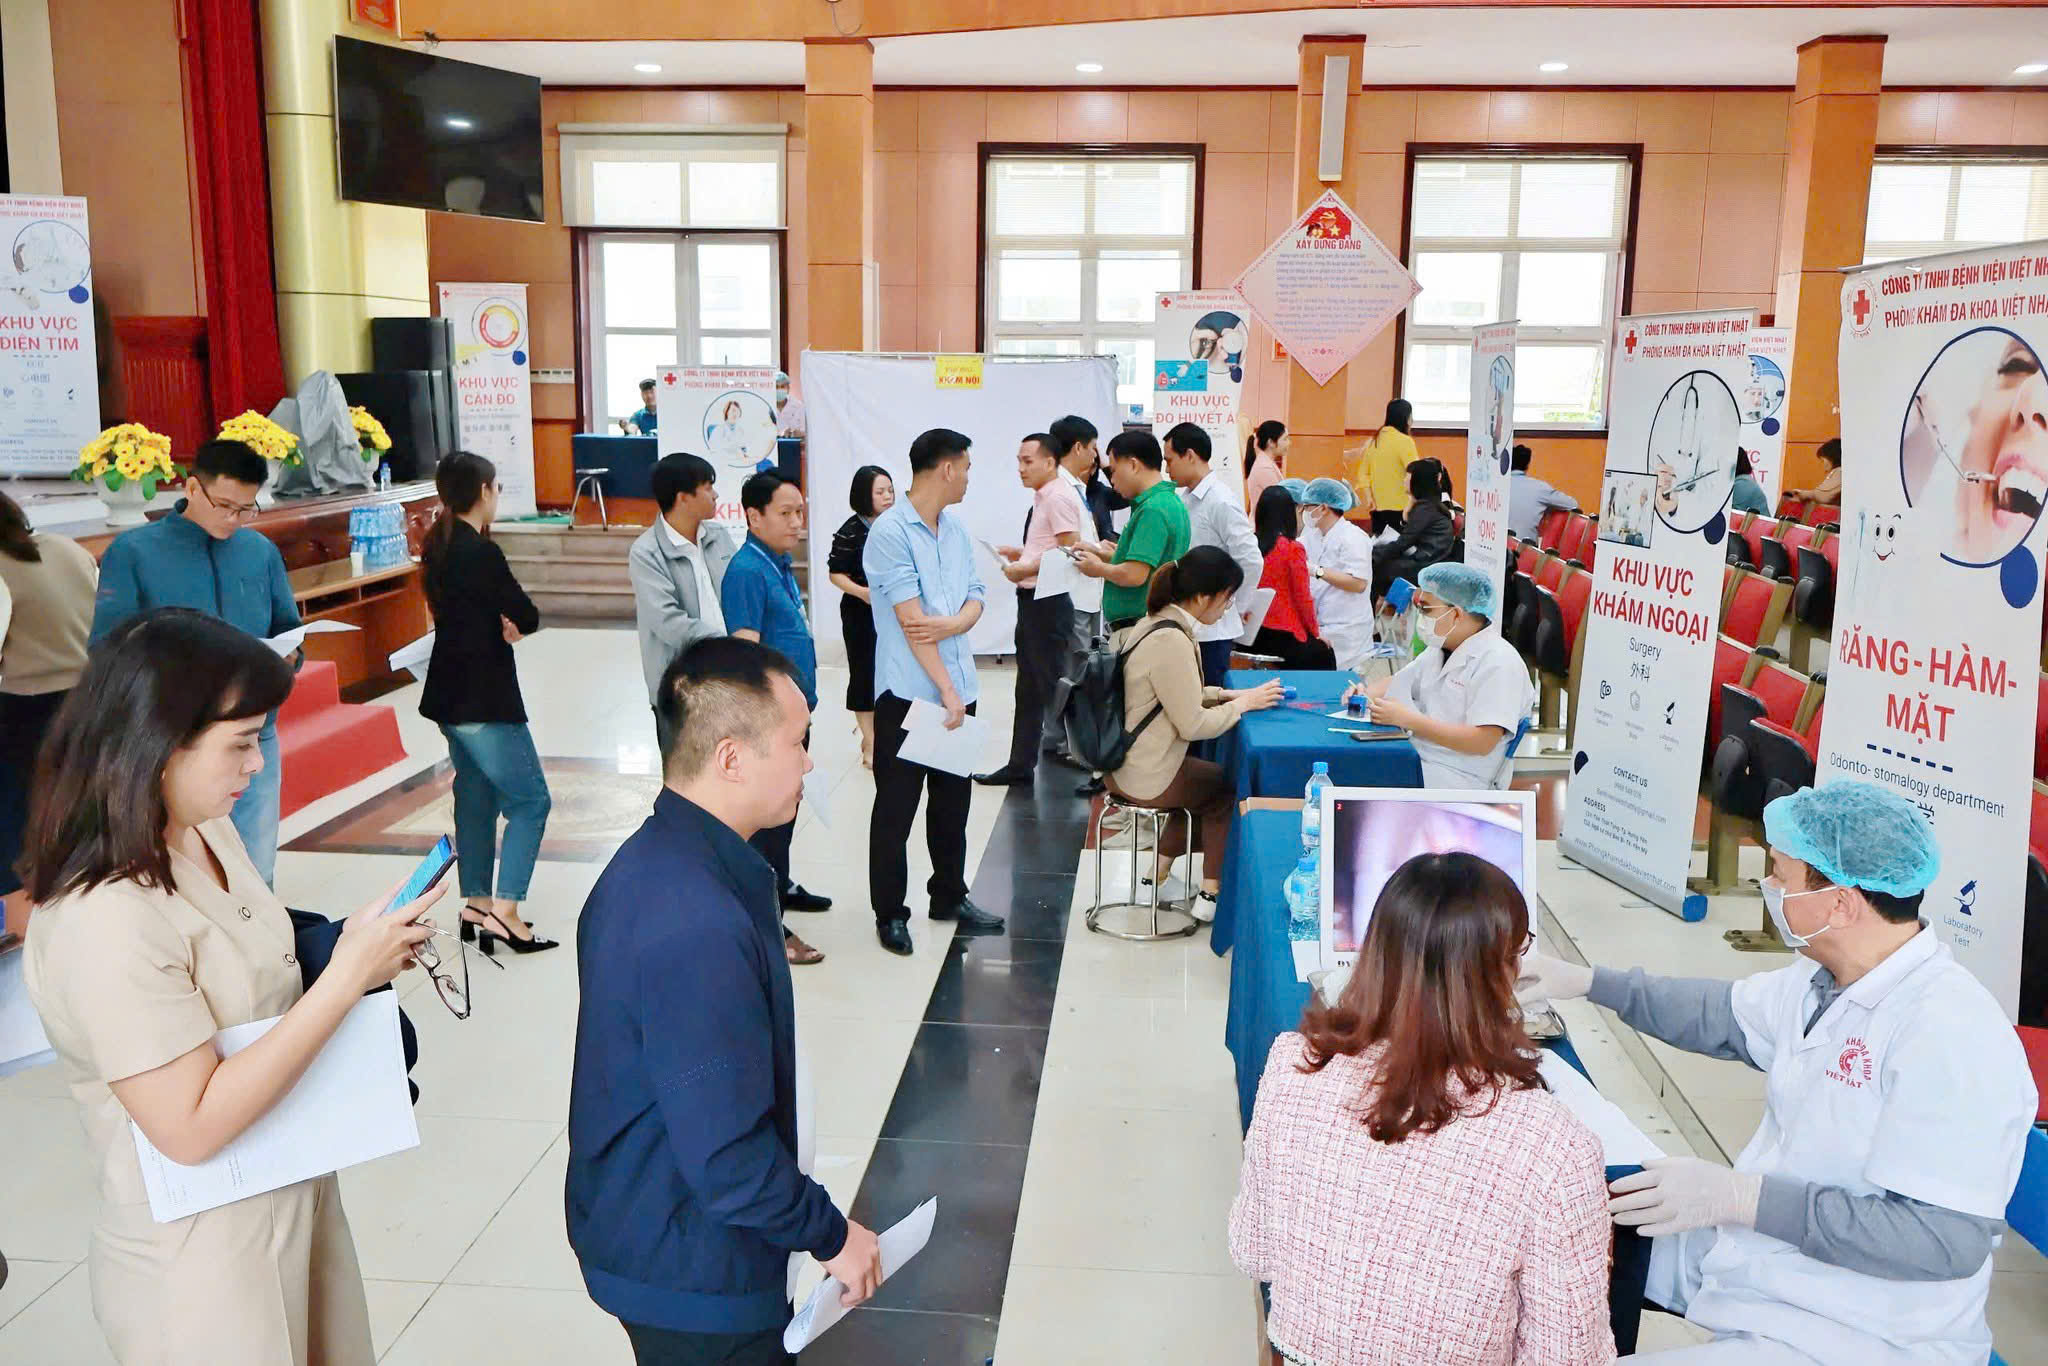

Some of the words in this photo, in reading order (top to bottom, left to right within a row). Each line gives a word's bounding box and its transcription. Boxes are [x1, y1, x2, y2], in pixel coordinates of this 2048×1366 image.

[1881, 274, 1911, 296] CÔNG
[1913, 272, 1923, 291] TY
[1924, 268, 1950, 290] TNHH
[1952, 264, 1980, 290] BỆNH
[1983, 259, 2006, 286] VIỆN
[2009, 256, 2033, 283] VIỆT
[1884, 305, 1916, 329] PHÒNG
[1916, 301, 1948, 324] KHÁM
[1950, 301, 1967, 322] ĐA
[1970, 299, 1998, 320] KHOA
[2002, 293, 2026, 321] VIỆT
[0, 315, 34, 329] KHU
[39, 314, 78, 334] VỰC
[1644, 321, 1660, 336] CÔNG
[1661, 323, 1668, 335] TY
[1668, 323, 1684, 335] TNHH
[1685, 320, 1701, 337] BỆNH
[1701, 319, 1716, 337] VIỆN
[1717, 318, 1730, 336] VIỆT
[1731, 317, 1749, 336] NHẬT
[45, 336, 79, 351] TIM
[1642, 343, 1662, 359] PHÒNG
[1663, 343, 1682, 358] KHÁM
[1682, 345, 1691, 358] ĐA
[1693, 345, 1710, 359] KHOA
[1711, 344, 1726, 360] VIỆT
[1727, 341, 1747, 360] NHẬT
[458, 376, 487, 389] KHU
[1170, 394, 1199, 407] KHU
[1202, 394, 1230, 409] VỰC
[1156, 412, 1177, 424] ĐO
[1612, 556, 1649, 587] KHU
[1654, 564, 1694, 600] VỰC
[1593, 590, 1644, 626] KHÁM
[1647, 602, 1709, 646] NGOẠI
[1629, 636, 1662, 662] Surgery
[1630, 661, 1652, 683] 外科
[1886, 691, 1956, 745] MẶT
[1613, 766, 1639, 783] CONTACT
[1639, 777, 1648, 788] US
[1830, 751, 1872, 775] Odonto-
[1873, 765, 1930, 798] stomalogy
[1933, 782, 2005, 819] department
[1583, 796, 1606, 813] ADDRESS
[1943, 914, 1984, 939] Laboratory
[1953, 932, 1970, 948] Test
